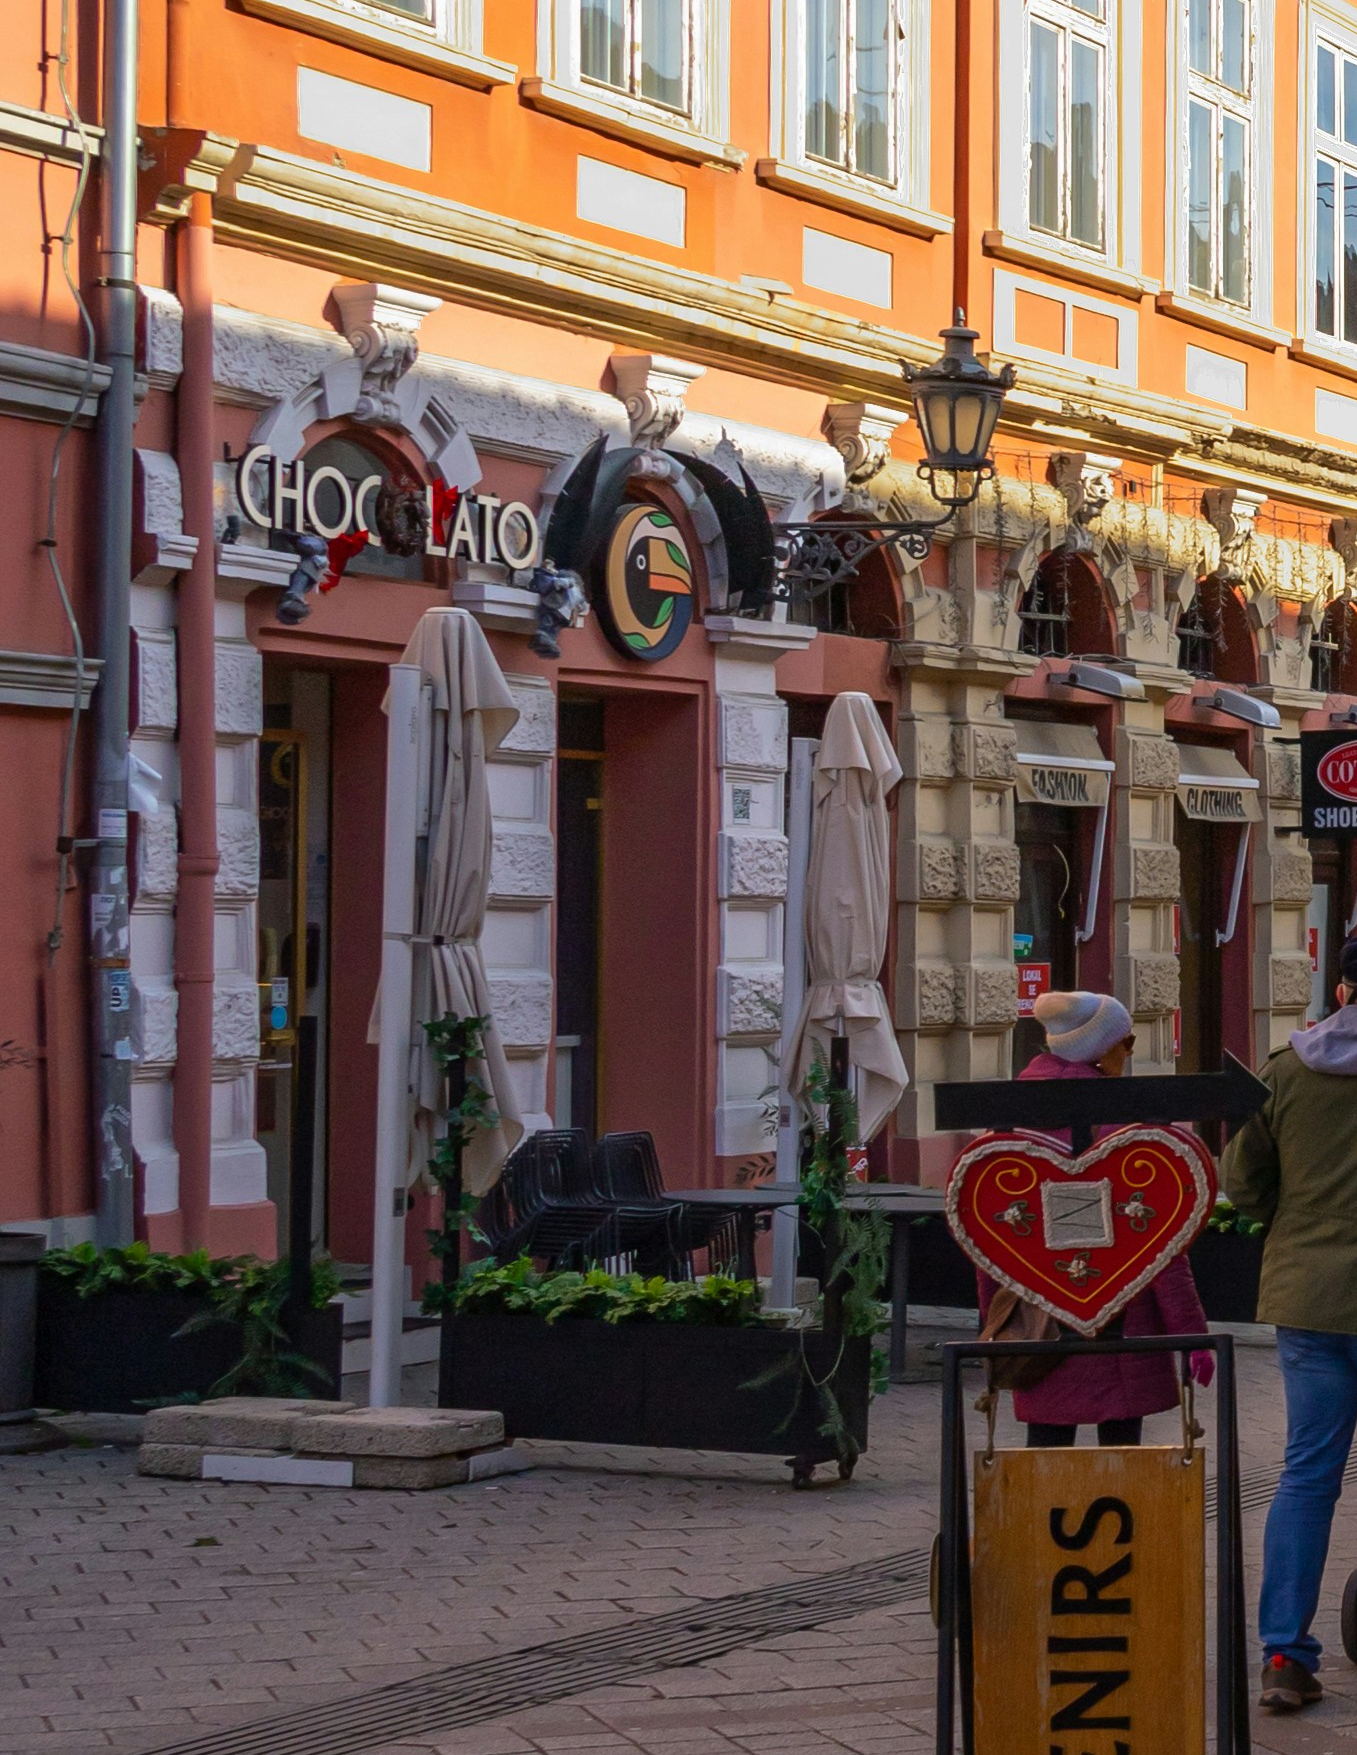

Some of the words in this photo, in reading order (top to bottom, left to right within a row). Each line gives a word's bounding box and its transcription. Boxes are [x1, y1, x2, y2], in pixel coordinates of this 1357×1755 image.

[238, 444, 538, 570] CHOCLATO
[1032, 769, 1089, 802] FASHION
[1186, 788, 1246, 817] CLOTHING
